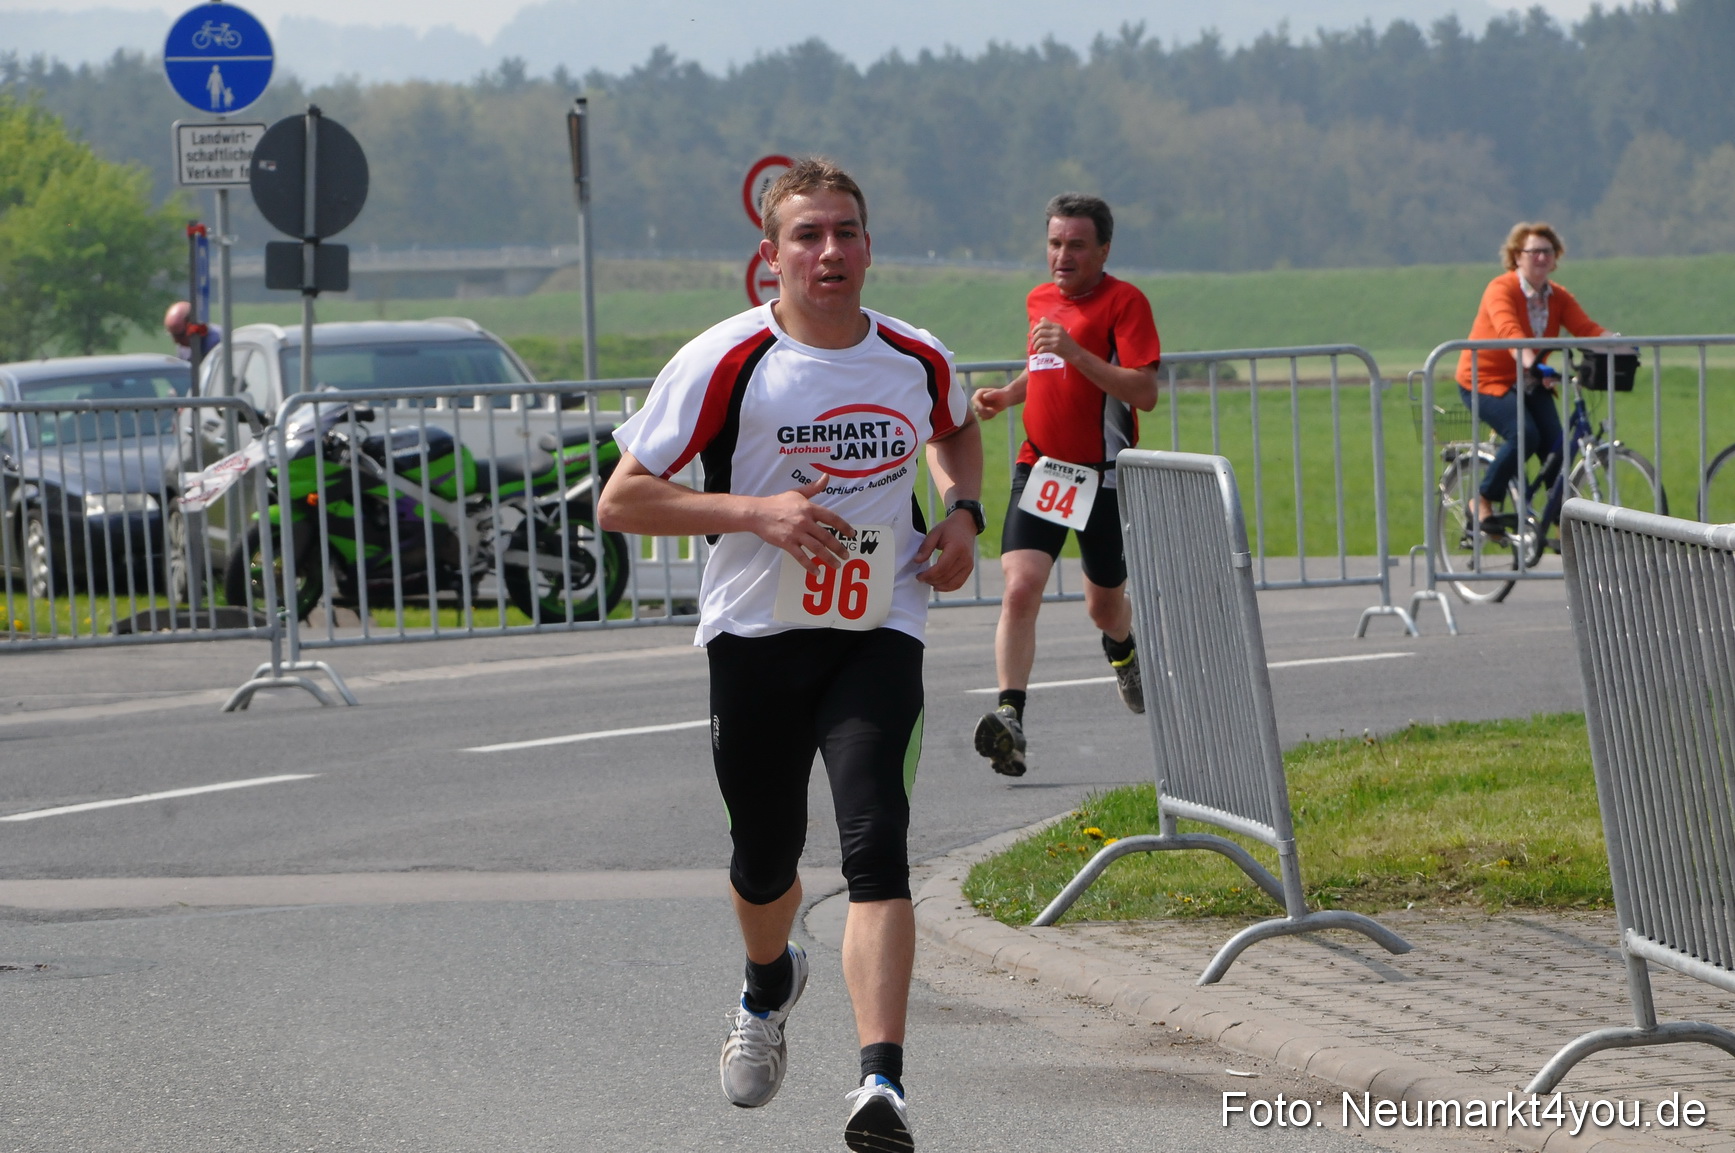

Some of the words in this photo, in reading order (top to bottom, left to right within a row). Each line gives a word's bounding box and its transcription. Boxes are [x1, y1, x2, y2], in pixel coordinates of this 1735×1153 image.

[191, 130, 253, 146] Landwirt-
[187, 147, 254, 162] schaftliche
[187, 164, 234, 180] Verkehr
[777, 421, 891, 444] GERHART
[894, 427, 904, 436] &
[779, 445, 832, 455] Autohaus
[830, 440, 906, 461] JÄNIG
[1044, 461, 1074, 475] MEYER
[790, 469, 812, 485] Das
[1036, 480, 1078, 519] 94
[802, 556, 870, 620] 96
